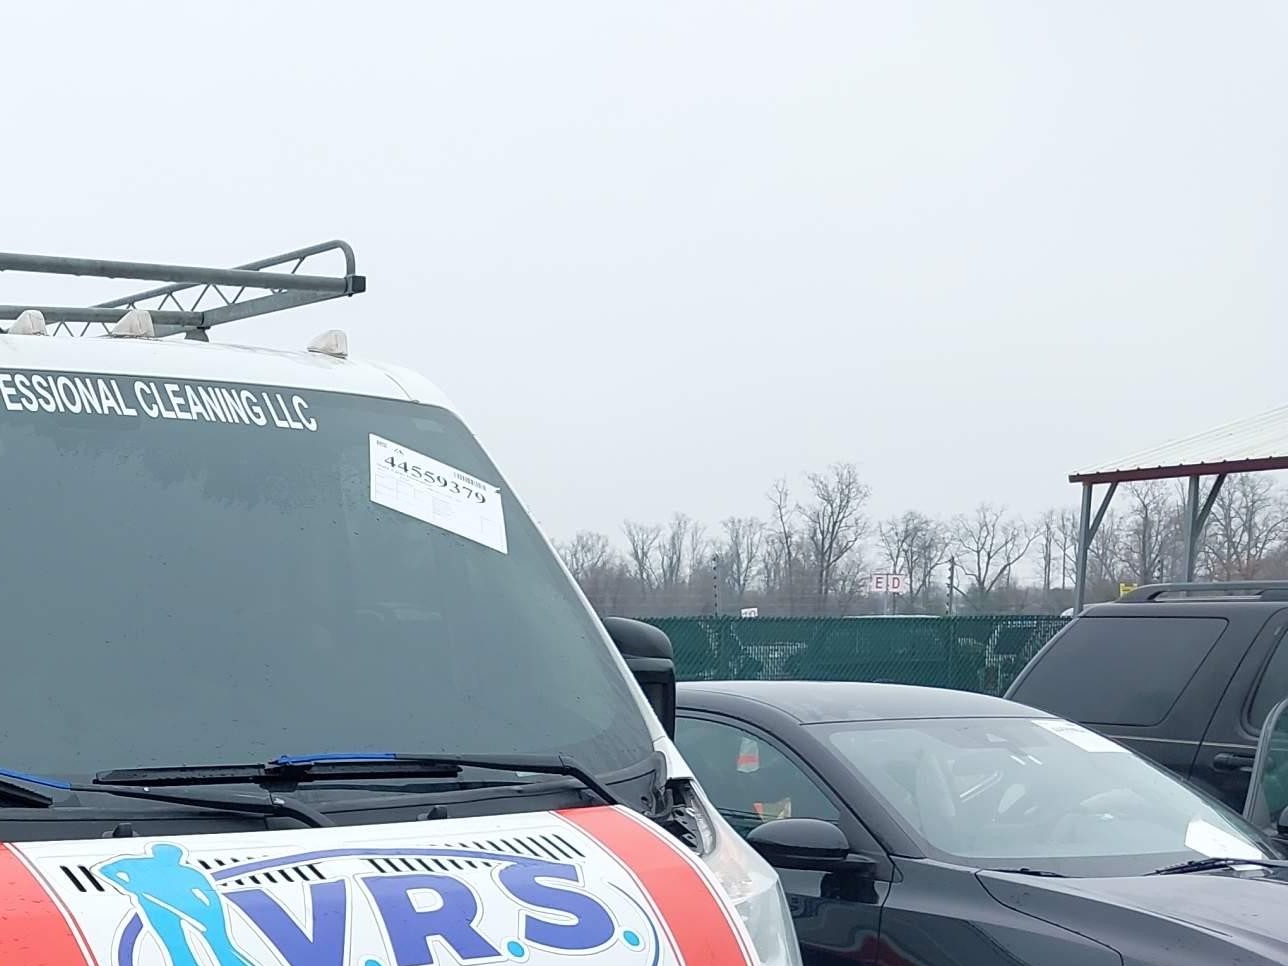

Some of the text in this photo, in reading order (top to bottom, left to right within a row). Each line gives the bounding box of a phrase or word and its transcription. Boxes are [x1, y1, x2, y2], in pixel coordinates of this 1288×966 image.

[134, 380, 267, 426] CLEANING
[262, 392, 318, 432] LLC
[384, 456, 487, 504] 44559379
[875, 576, 900, 589] E D
